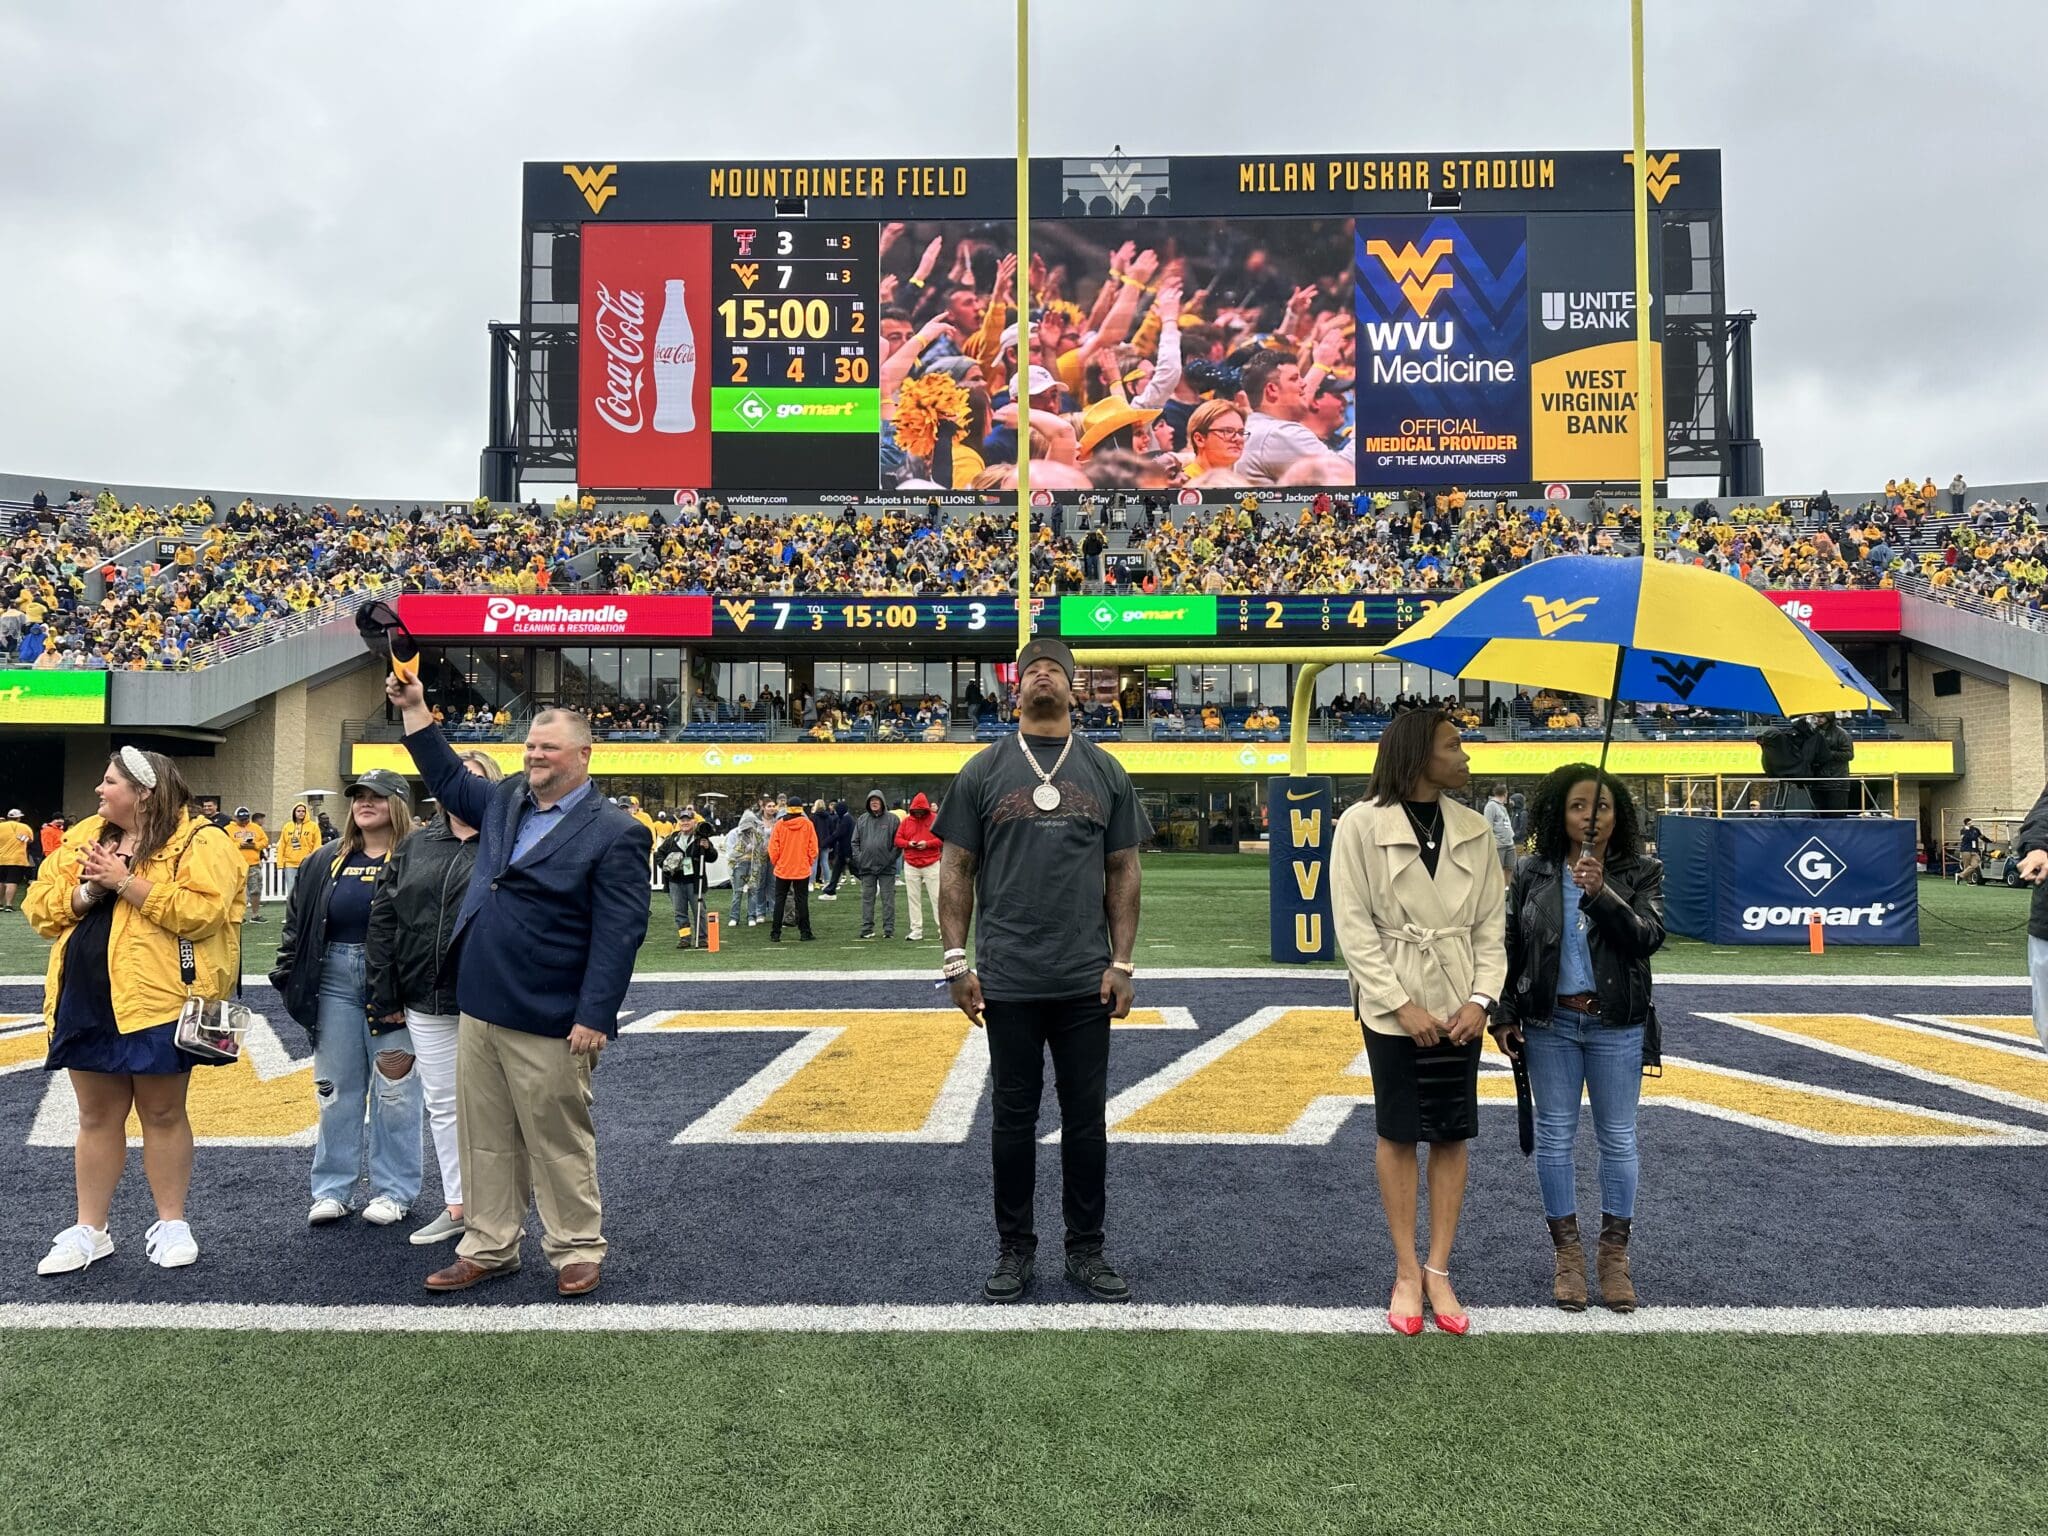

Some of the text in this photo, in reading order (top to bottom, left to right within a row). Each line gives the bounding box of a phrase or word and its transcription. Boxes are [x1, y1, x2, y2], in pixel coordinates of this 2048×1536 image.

[710, 167, 967, 197] MOUNTAINEER FIELD
[1239, 159, 1555, 192] MILAN PUSKAR STADIUM
[777, 231, 793, 255] 3
[841, 236, 851, 249] 3
[777, 266, 793, 289] 7
[841, 270, 851, 283] 3
[718, 299, 830, 339] 15:00
[851, 312, 865, 333] 2
[1569, 311, 1630, 329] BANK
[1366, 321, 1453, 351] WVU
[595, 280, 645, 433] Coca-Cola
[731, 357, 748, 383] 2
[786, 357, 805, 383] 4
[834, 357, 869, 383] 30
[1373, 353, 1515, 384] Medicine
[1565, 370, 1627, 389] WEST
[776, 402, 855, 418] gomart
[1541, 392, 1653, 412] VIRGINIA'
[1400, 418, 1484, 436] OFFICIAL
[1567, 415, 1628, 434] BANK
[1365, 434, 1518, 452] MEDICAL PROVIDER
[1377, 453, 1507, 466] OF THE MOUNTAINEERS
[726, 494, 788, 505] wvlottery.com
[864, 495, 901, 505] Jackpots
[903, 495, 912, 504] in
[913, 495, 926, 504] the
[1335, 493, 1350, 501] the
[514, 604, 628, 623] Panhandle
[772, 602, 791, 630] 7
[811, 615, 823, 631] 3
[842, 604, 917, 628] 15:00
[935, 615, 947, 631] 3
[967, 602, 987, 630] 3
[1122, 609, 1185, 622] gomart
[1265, 601, 1284, 629] 2
[1347, 600, 1368, 628] 4
[513, 623, 626, 633] CLEANING & RESTORATION
[1742, 902, 1886, 931] gomart
